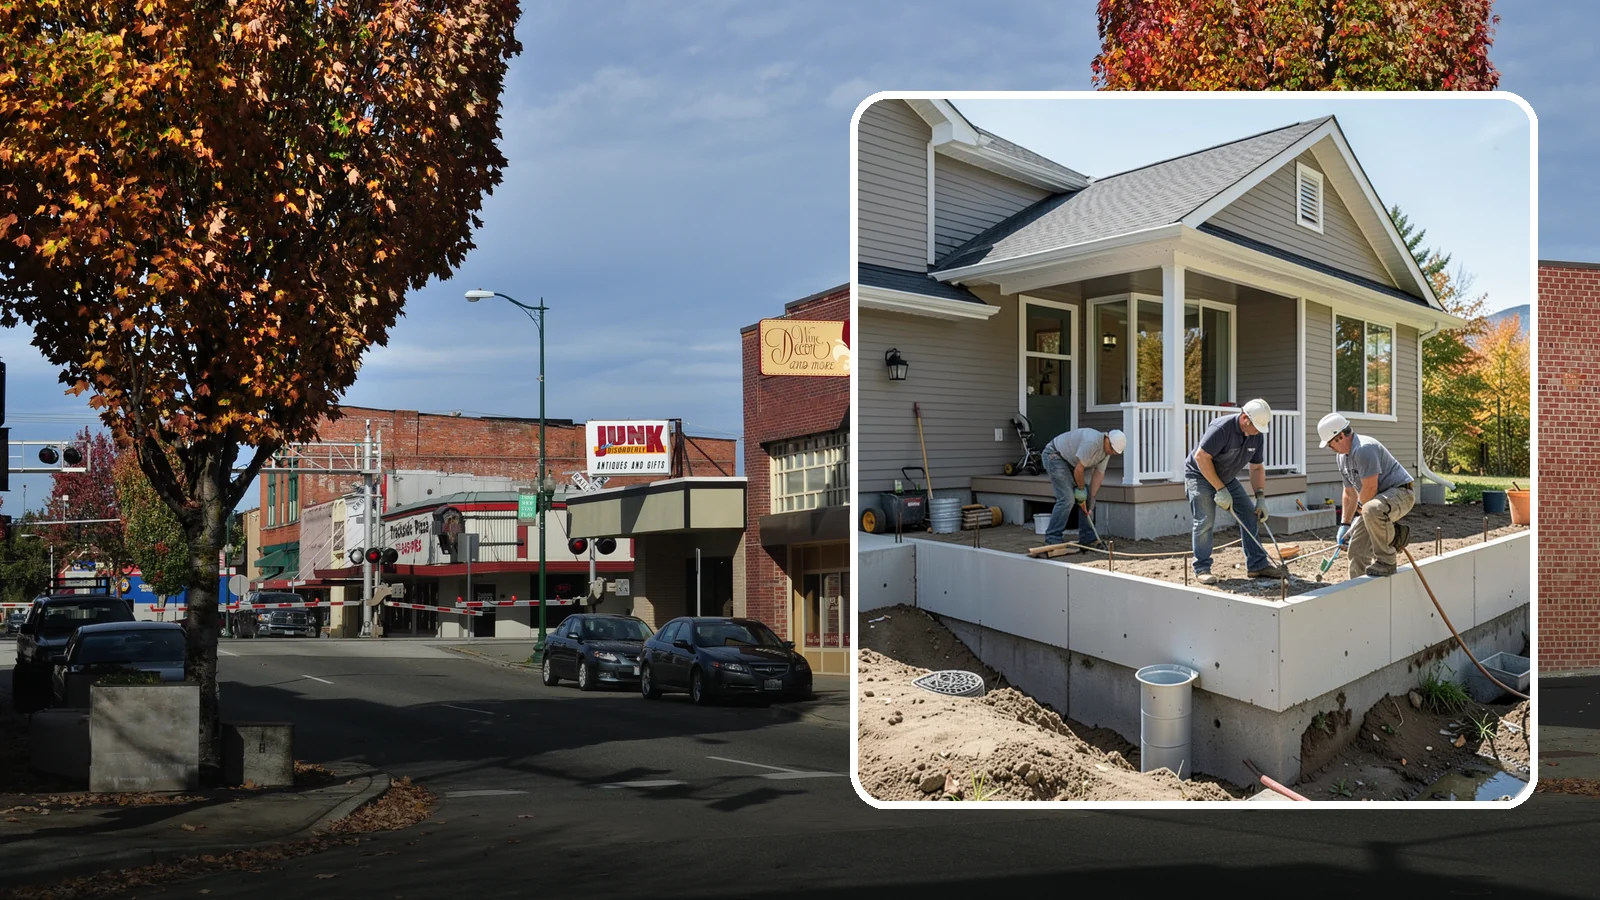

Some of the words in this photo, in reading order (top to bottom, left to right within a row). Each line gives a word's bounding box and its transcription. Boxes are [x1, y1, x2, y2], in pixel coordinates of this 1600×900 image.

[595, 425, 665, 457] JUNK
[607, 446, 646, 454] DISORDERLY
[597, 461, 628, 470] ANTIQUES
[631, 461, 644, 470] AND
[647, 460, 665, 469] GIFTS
[573, 473, 589, 492] RAIL
[414, 519, 429, 535] Pizza
